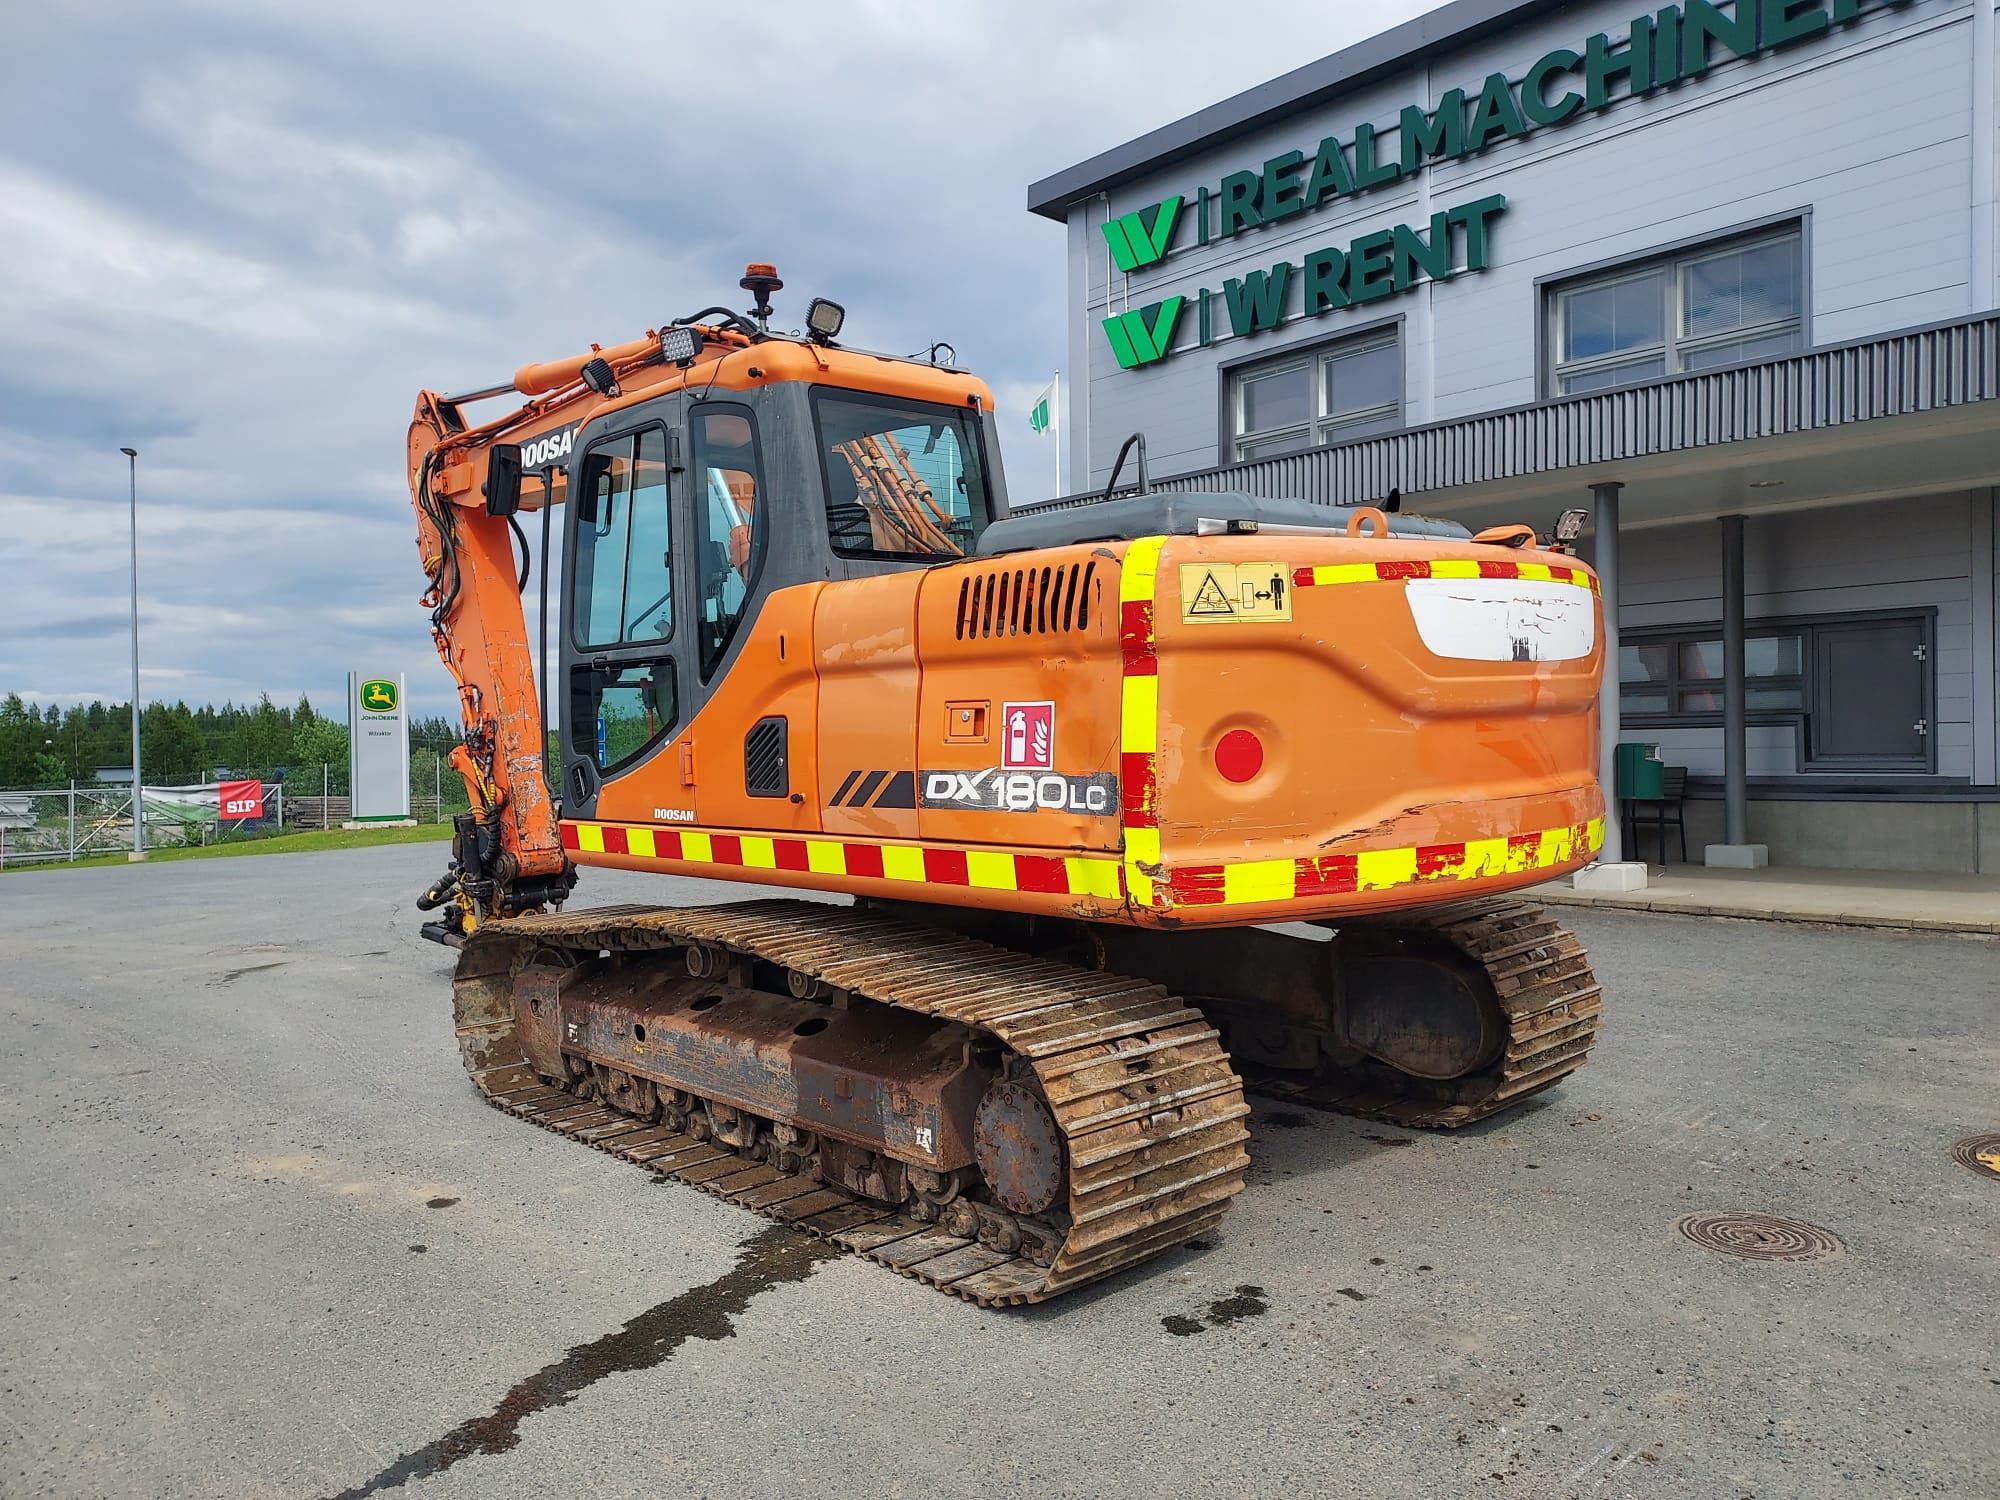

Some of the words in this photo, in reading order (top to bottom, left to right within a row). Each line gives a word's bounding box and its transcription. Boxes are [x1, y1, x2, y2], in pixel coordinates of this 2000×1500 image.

[1223, 261, 1291, 337] W
[1304, 194, 1507, 317] RENT
[226, 800, 256, 814] SIP
[654, 808, 694, 821] DOOSAN
